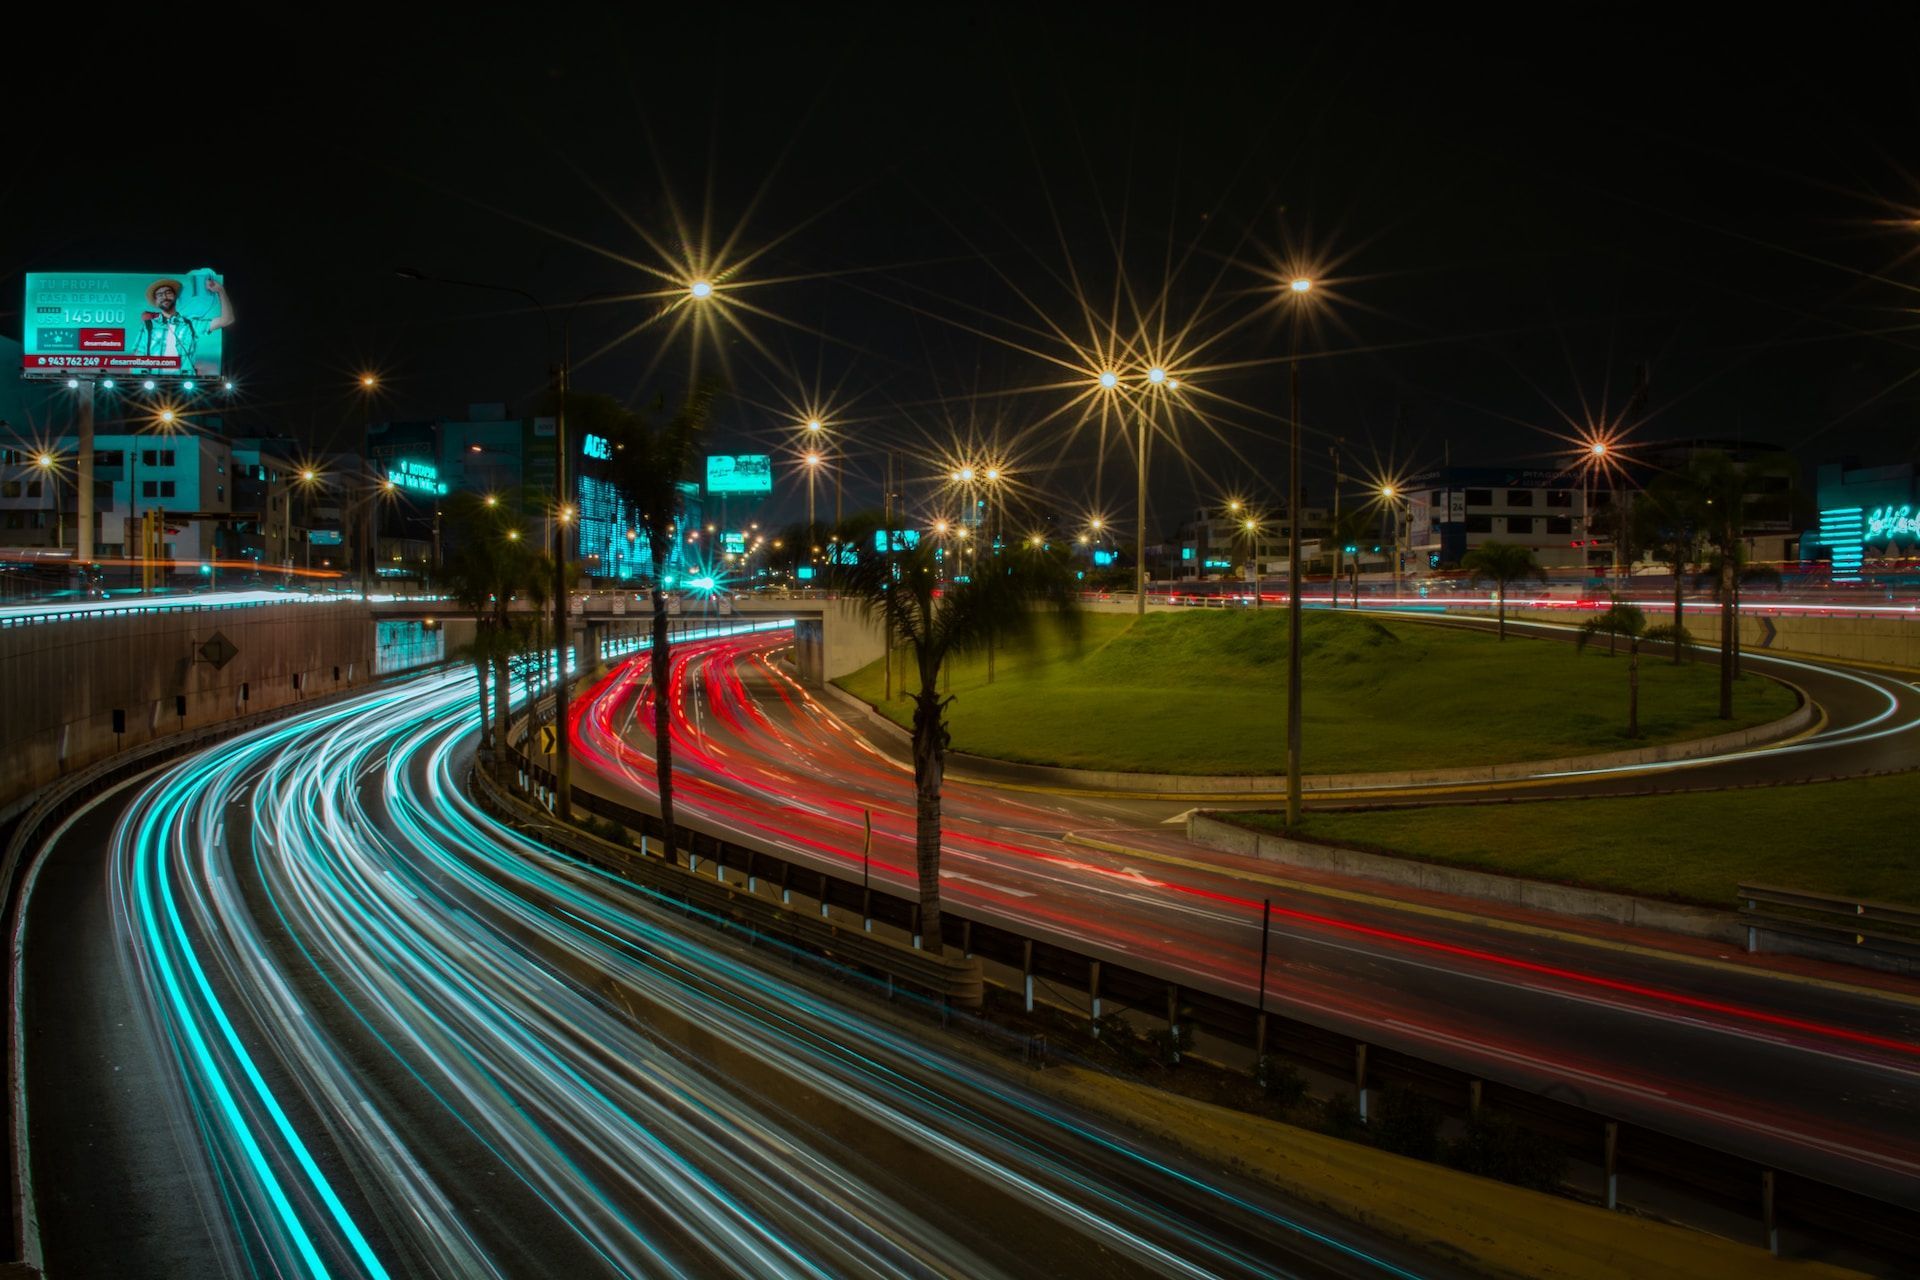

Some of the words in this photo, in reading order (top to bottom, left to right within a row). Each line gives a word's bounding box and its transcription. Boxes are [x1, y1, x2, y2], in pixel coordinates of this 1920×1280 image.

[39, 279, 55, 289] TU
[62, 279, 110, 289] PROPIA
[64, 308, 125, 323] 145.000
[48, 357, 64, 366] 943
[66, 357, 82, 366] 762
[83, 357, 100, 366] 249
[110, 358, 177, 367] desarrolladora.com
